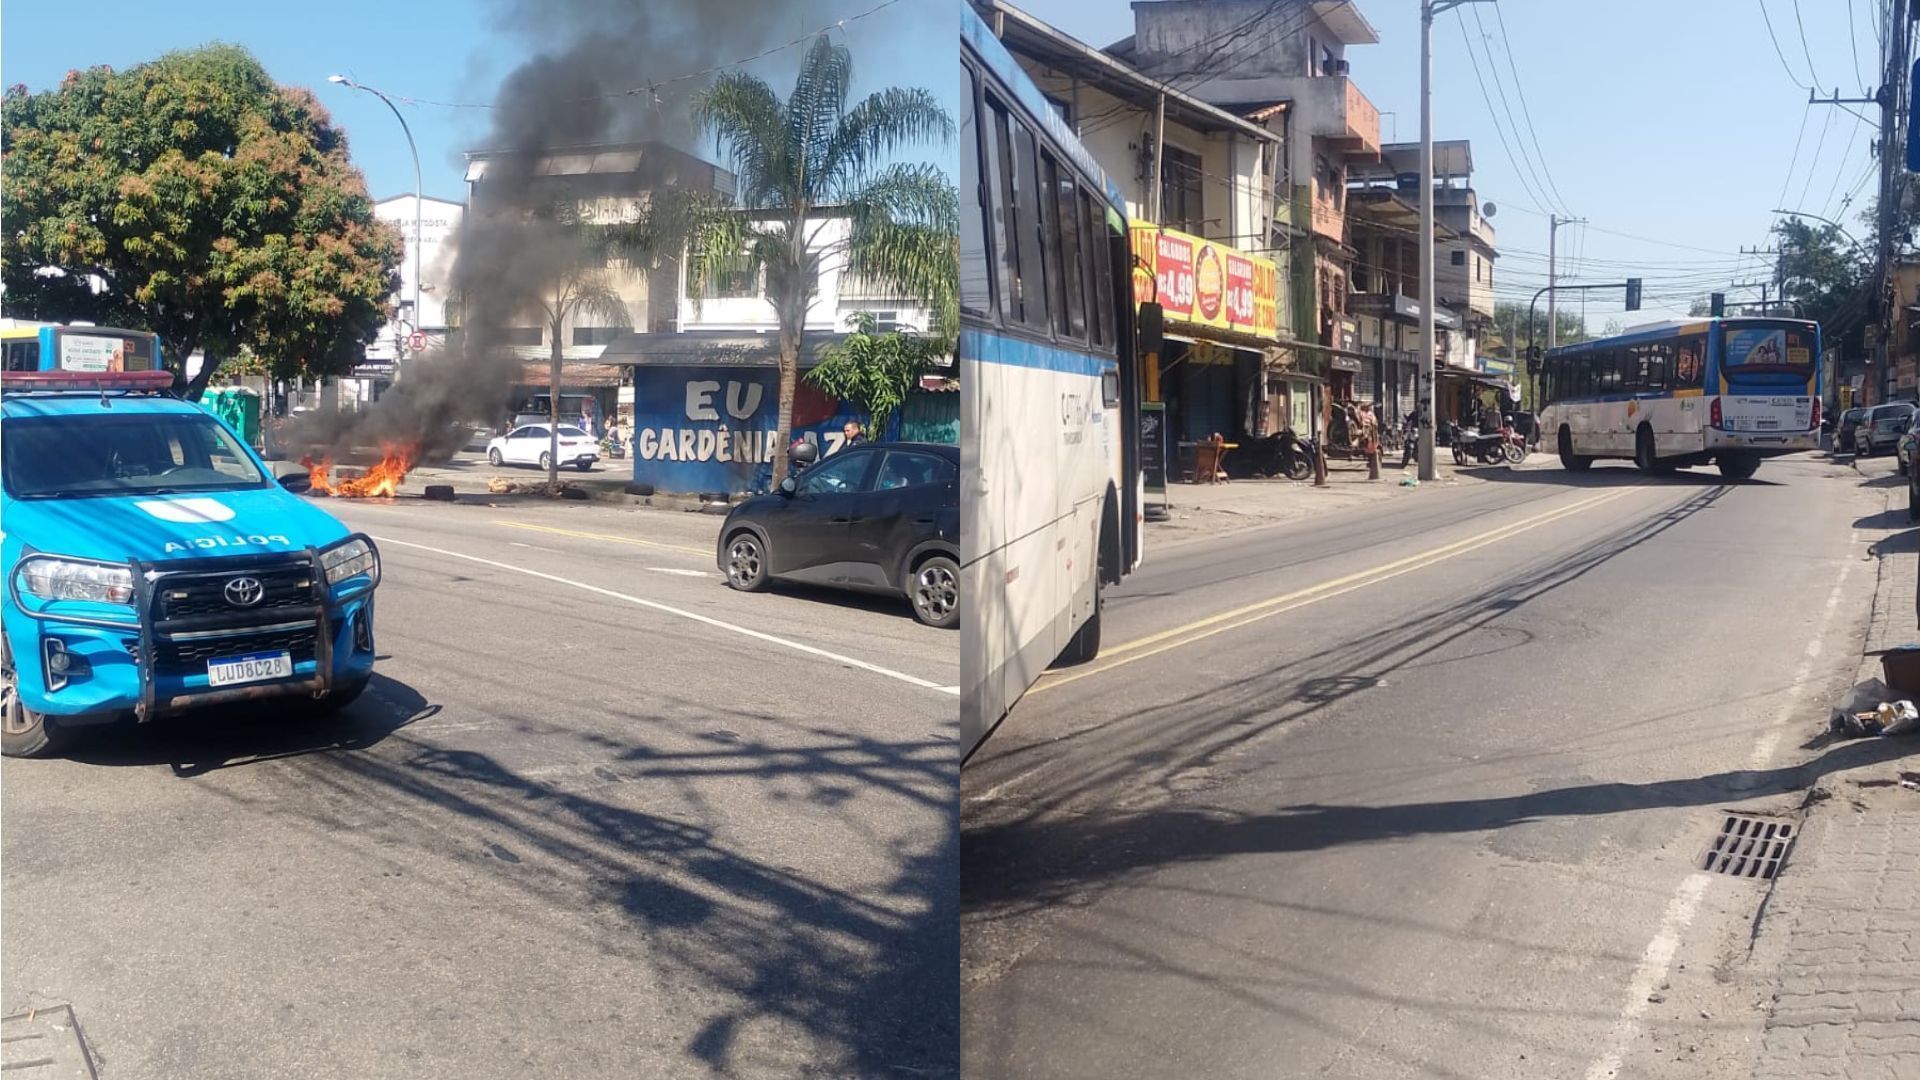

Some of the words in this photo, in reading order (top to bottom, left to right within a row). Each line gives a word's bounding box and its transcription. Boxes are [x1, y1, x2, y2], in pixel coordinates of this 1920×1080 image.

[686, 381, 763, 420] EU
[639, 423, 778, 464] GARDÊNIA
[216, 659, 282, 682] LUD8C28
